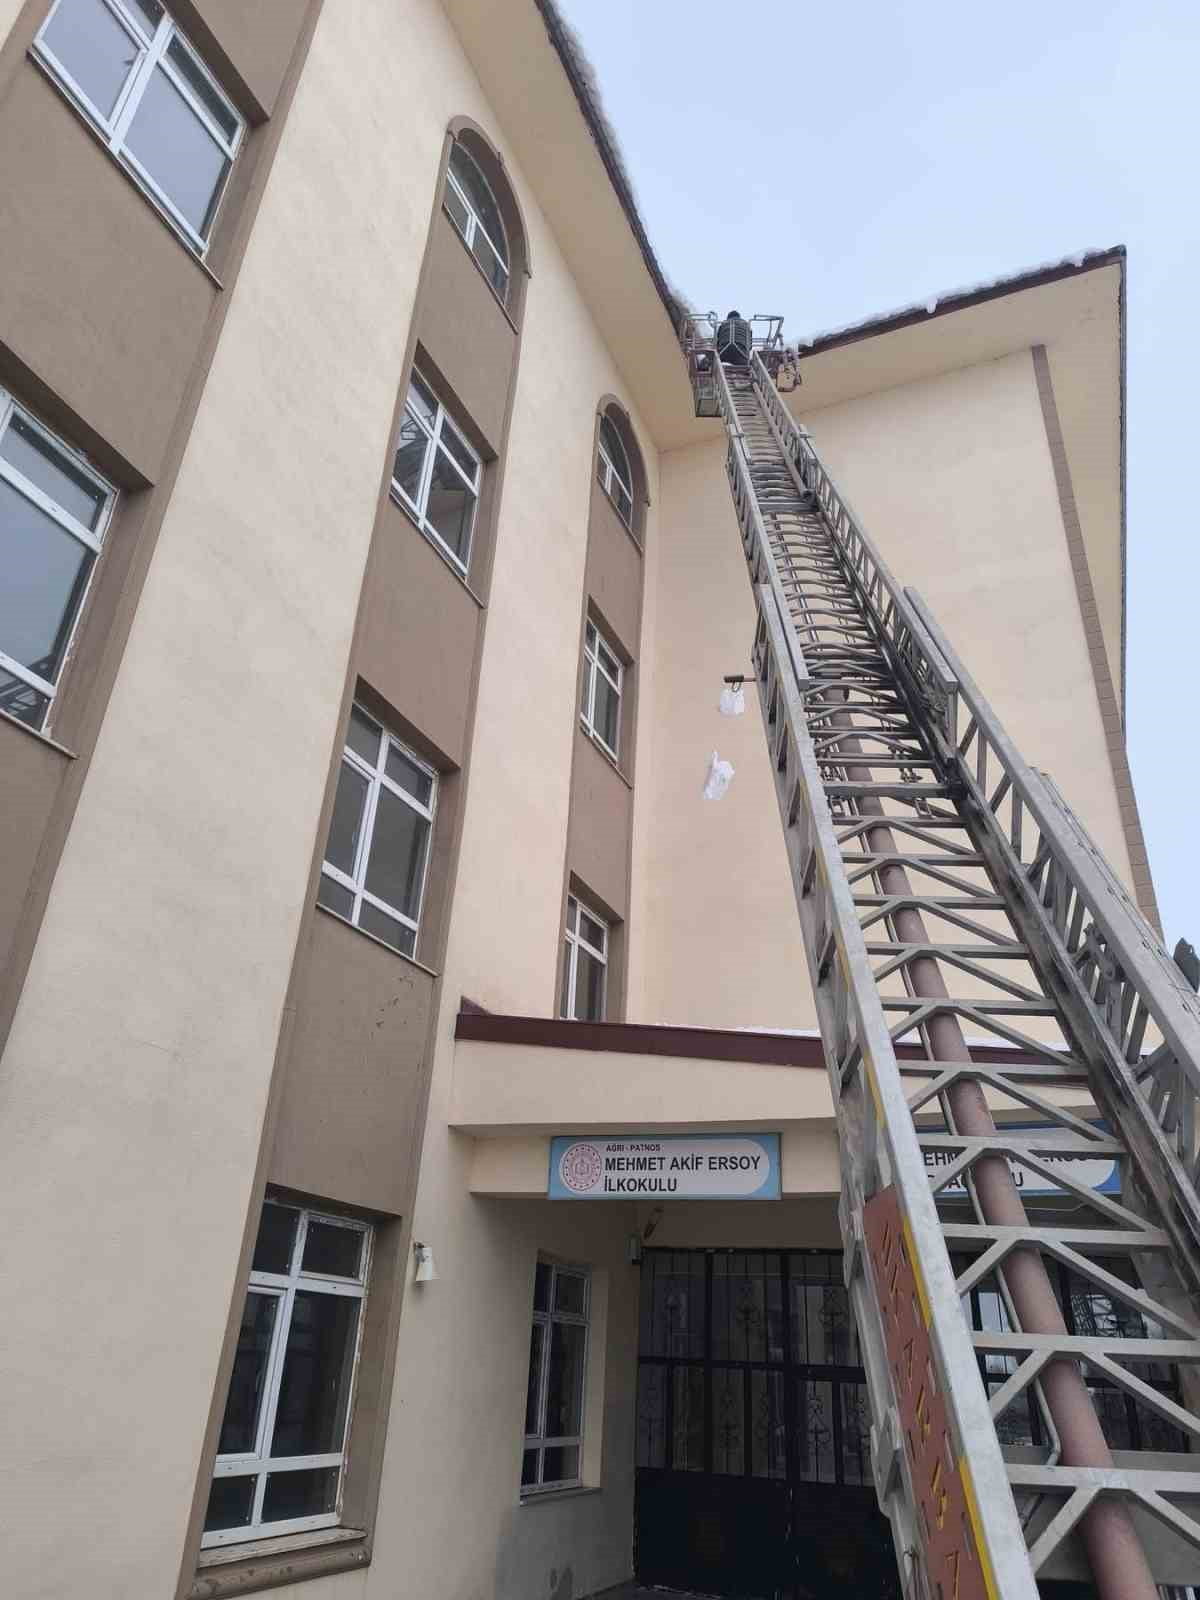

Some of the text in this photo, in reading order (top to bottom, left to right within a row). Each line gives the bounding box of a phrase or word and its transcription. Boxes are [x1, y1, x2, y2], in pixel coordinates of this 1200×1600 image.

[630, 1144, 661, 1152] PATNOS
[605, 1153, 761, 1171] MEHMET AKİF ERSOY
[604, 1175, 677, 1192] İLKOKULU
